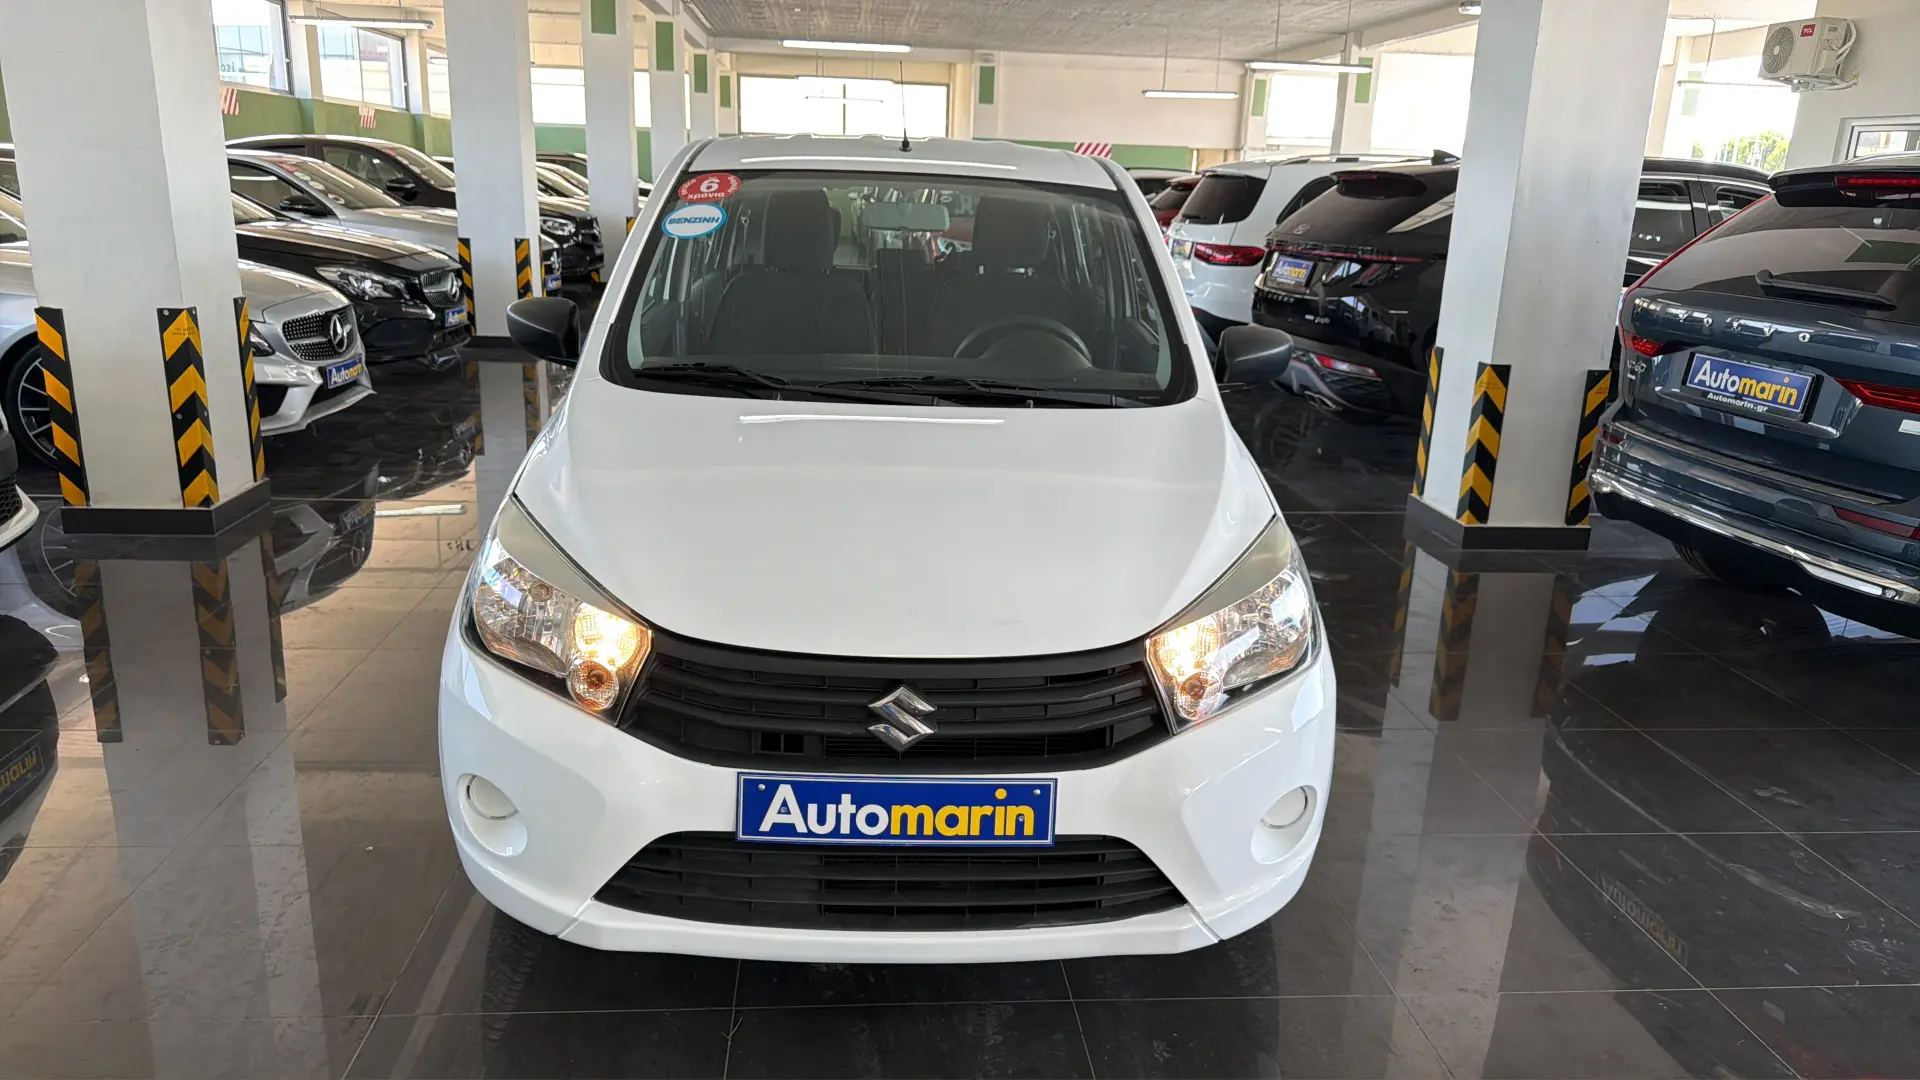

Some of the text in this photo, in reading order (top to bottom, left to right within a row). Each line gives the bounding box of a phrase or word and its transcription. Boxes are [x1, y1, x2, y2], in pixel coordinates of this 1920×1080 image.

[700, 179, 720, 193] 6
[1693, 359, 1798, 406] Automarin
[1707, 392, 1768, 412] Automarin.gr
[758, 784, 1034, 837] Automarin
